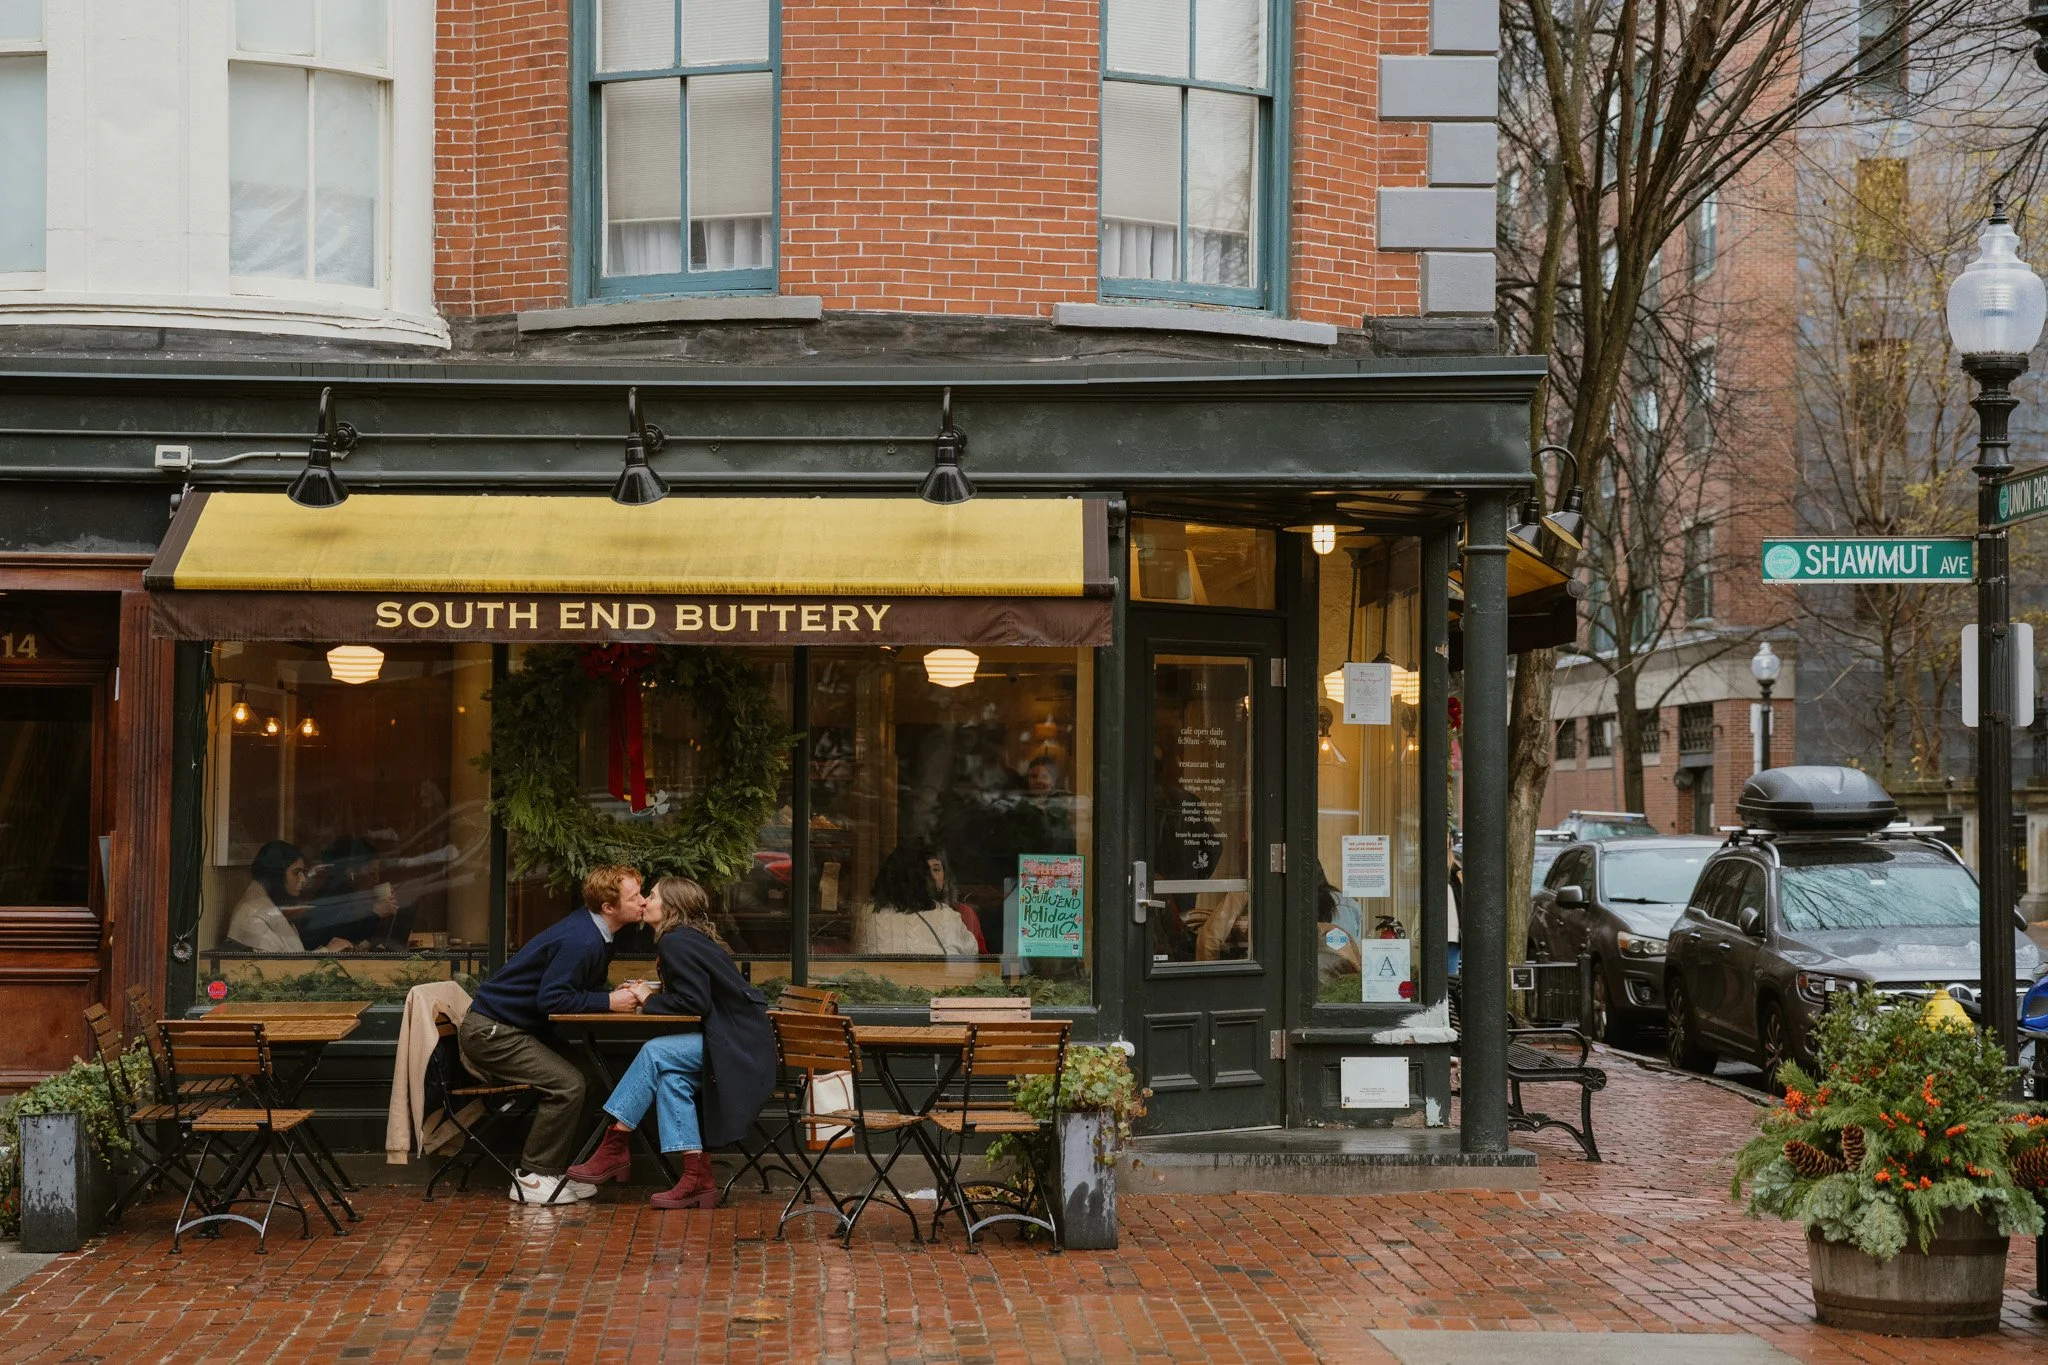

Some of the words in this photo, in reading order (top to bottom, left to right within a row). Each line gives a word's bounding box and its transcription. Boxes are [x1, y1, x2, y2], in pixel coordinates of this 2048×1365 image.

[2009, 480, 2031, 516] UNION
[2033, 474, 2048, 509] PAR
[1804, 544, 1933, 575] SHAWMUT
[1939, 556, 1969, 575] AVE
[375, 601, 537, 629] SOUTH
[559, 601, 656, 630] END
[675, 604, 892, 632] BUTTERY
[1, 633, 38, 659] 14
[1180, 726, 1193, 735] café
[1193, 728, 1209, 738] open
[1210, 727, 1224, 738] daily
[1208, 737, 1227, 748] :00pm
[1215, 760, 1226, 769] bar
[1181, 808, 1200, 816] thursday
[1024, 886, 1053, 905] South
[1056, 897, 1081, 910] END
[1024, 905, 1078, 935] Holiday
[1027, 923, 1059, 939] Stroll
[1378, 956, 1397, 976] A
